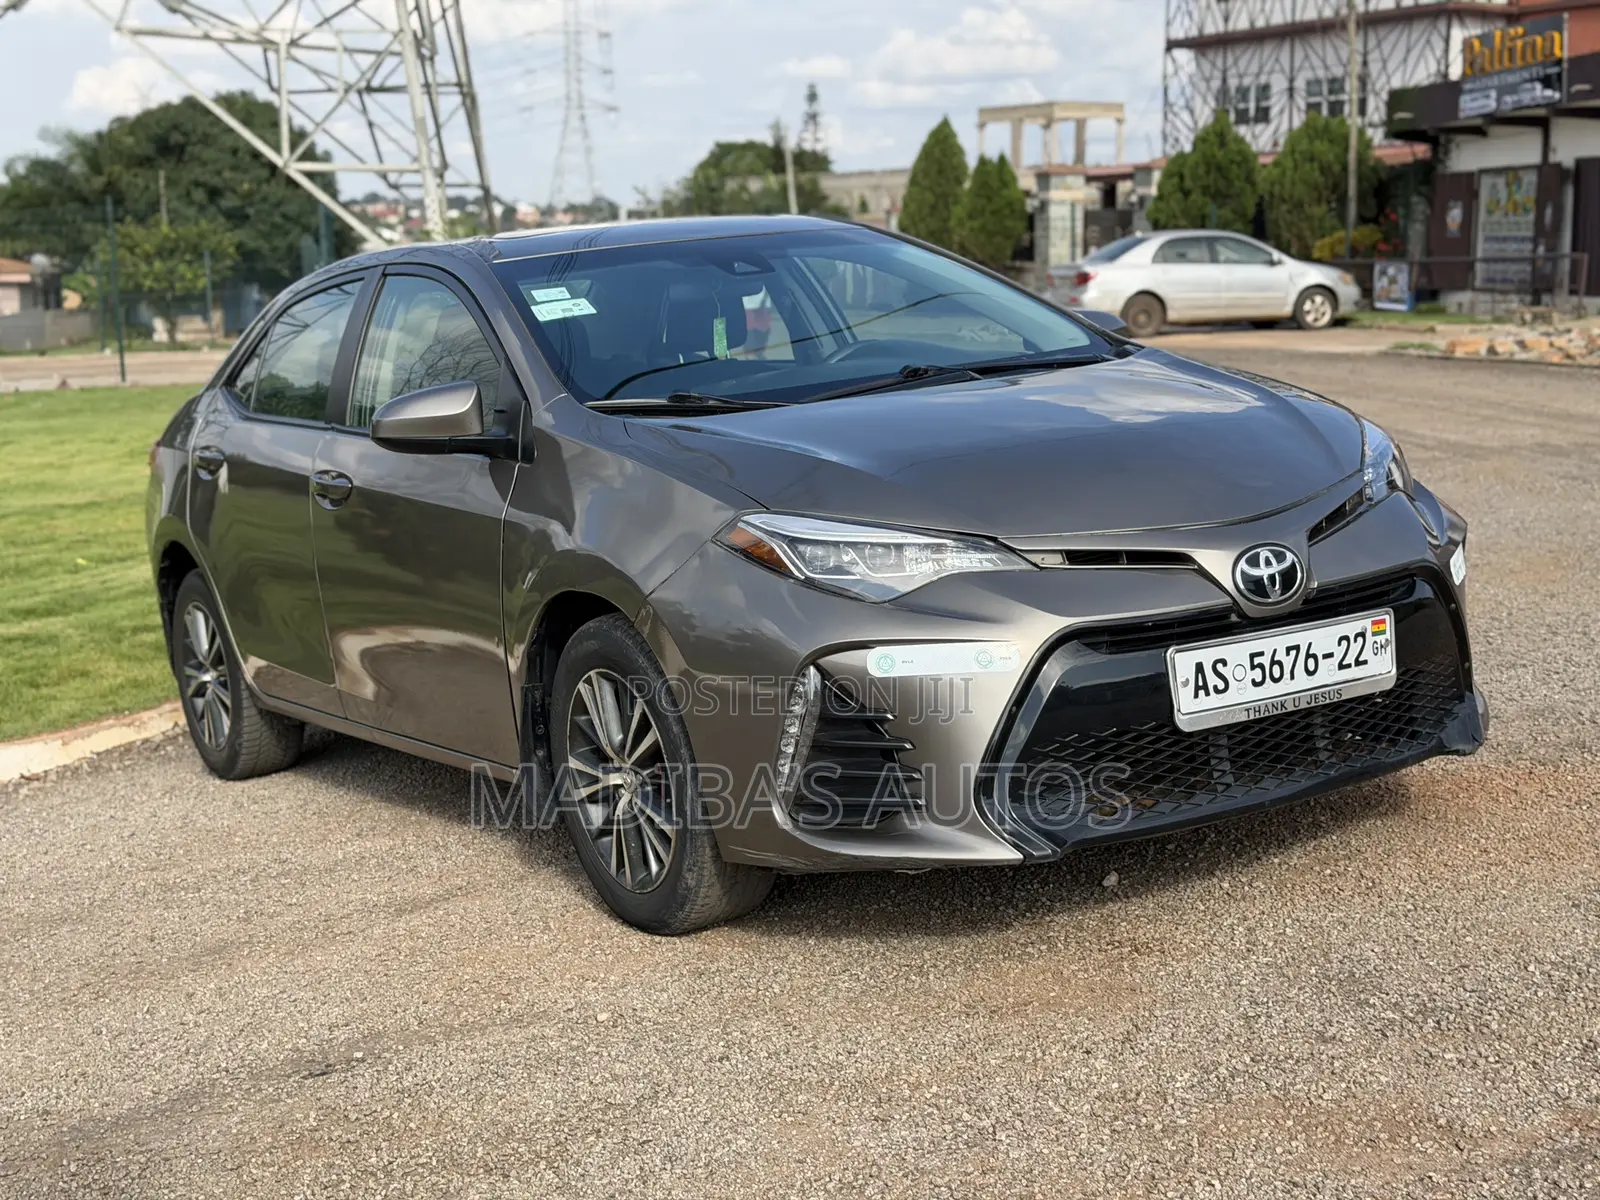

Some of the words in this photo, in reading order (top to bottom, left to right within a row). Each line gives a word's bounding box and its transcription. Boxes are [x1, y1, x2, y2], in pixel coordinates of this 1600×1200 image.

[1192, 657, 1230, 700] AS
[1249, 631, 1369, 689] 5676-22
[1244, 700, 1288, 720] THANK
[1293, 696, 1301, 709] U
[1306, 688, 1343, 706] JESUS
